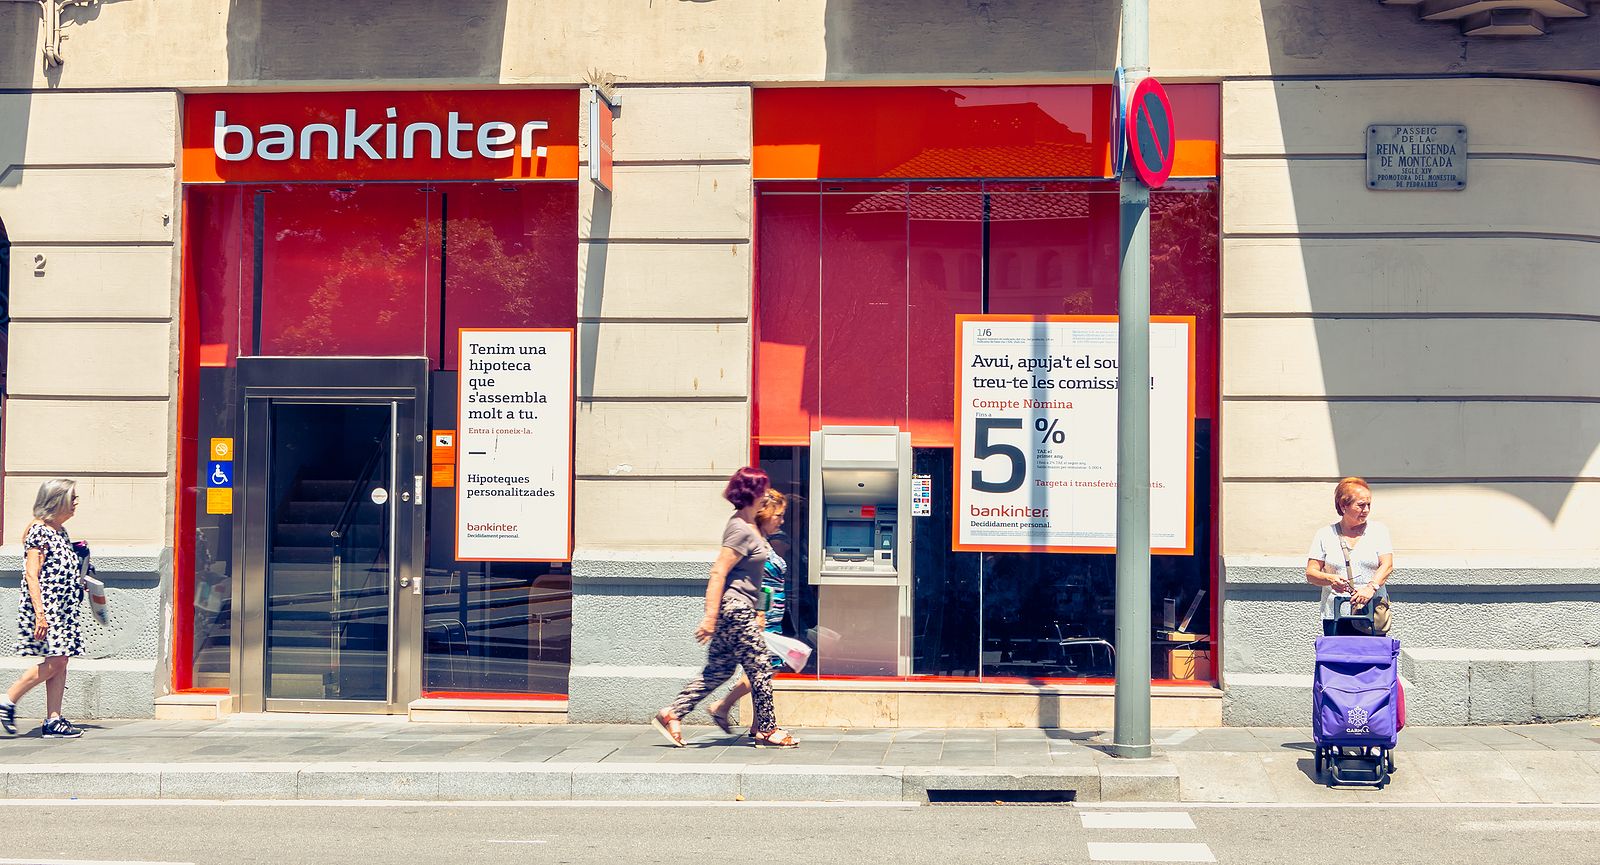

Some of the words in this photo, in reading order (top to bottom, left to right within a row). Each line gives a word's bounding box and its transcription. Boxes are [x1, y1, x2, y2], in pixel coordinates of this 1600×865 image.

[214, 107, 548, 161] bankinter.
[1396, 127, 1437, 135] PASSEIG
[1376, 144, 1405, 155] REINA
[1411, 144, 1457, 155] ELISENDA
[1381, 156, 1393, 167] DE
[1398, 156, 1453, 167] MONTCADA
[34, 254, 47, 278] 2
[976, 328, 992, 338] 1/6
[469, 343, 515, 355] Tenim
[518, 346, 547, 355] una
[469, 359, 532, 374] hipoteca
[971, 355, 1014, 370] Avui,
[1017, 355, 1073, 373] apuja't
[1075, 355, 1091, 369] el
[468, 378, 495, 390] que
[972, 376, 1029, 389] treu-te
[1031, 375, 1055, 390] les
[468, 391, 548, 404] s'assembla
[972, 398, 1020, 411] Compte
[1023, 397, 1073, 410] Nòmina
[468, 407, 503, 419] molt
[506, 410, 515, 419] a
[519, 409, 538, 419] tu.
[495, 427, 533, 435] coneix-la.
[971, 418, 1027, 494] 5
[1035, 418, 1066, 444] %
[467, 474, 530, 485] Hipoteques
[1035, 479, 1068, 488] Targeta
[467, 488, 555, 498] personalitzades
[970, 504, 1049, 518] bankinter.
[467, 522, 518, 532] bankinter.
[1019, 521, 1052, 530] personal.
